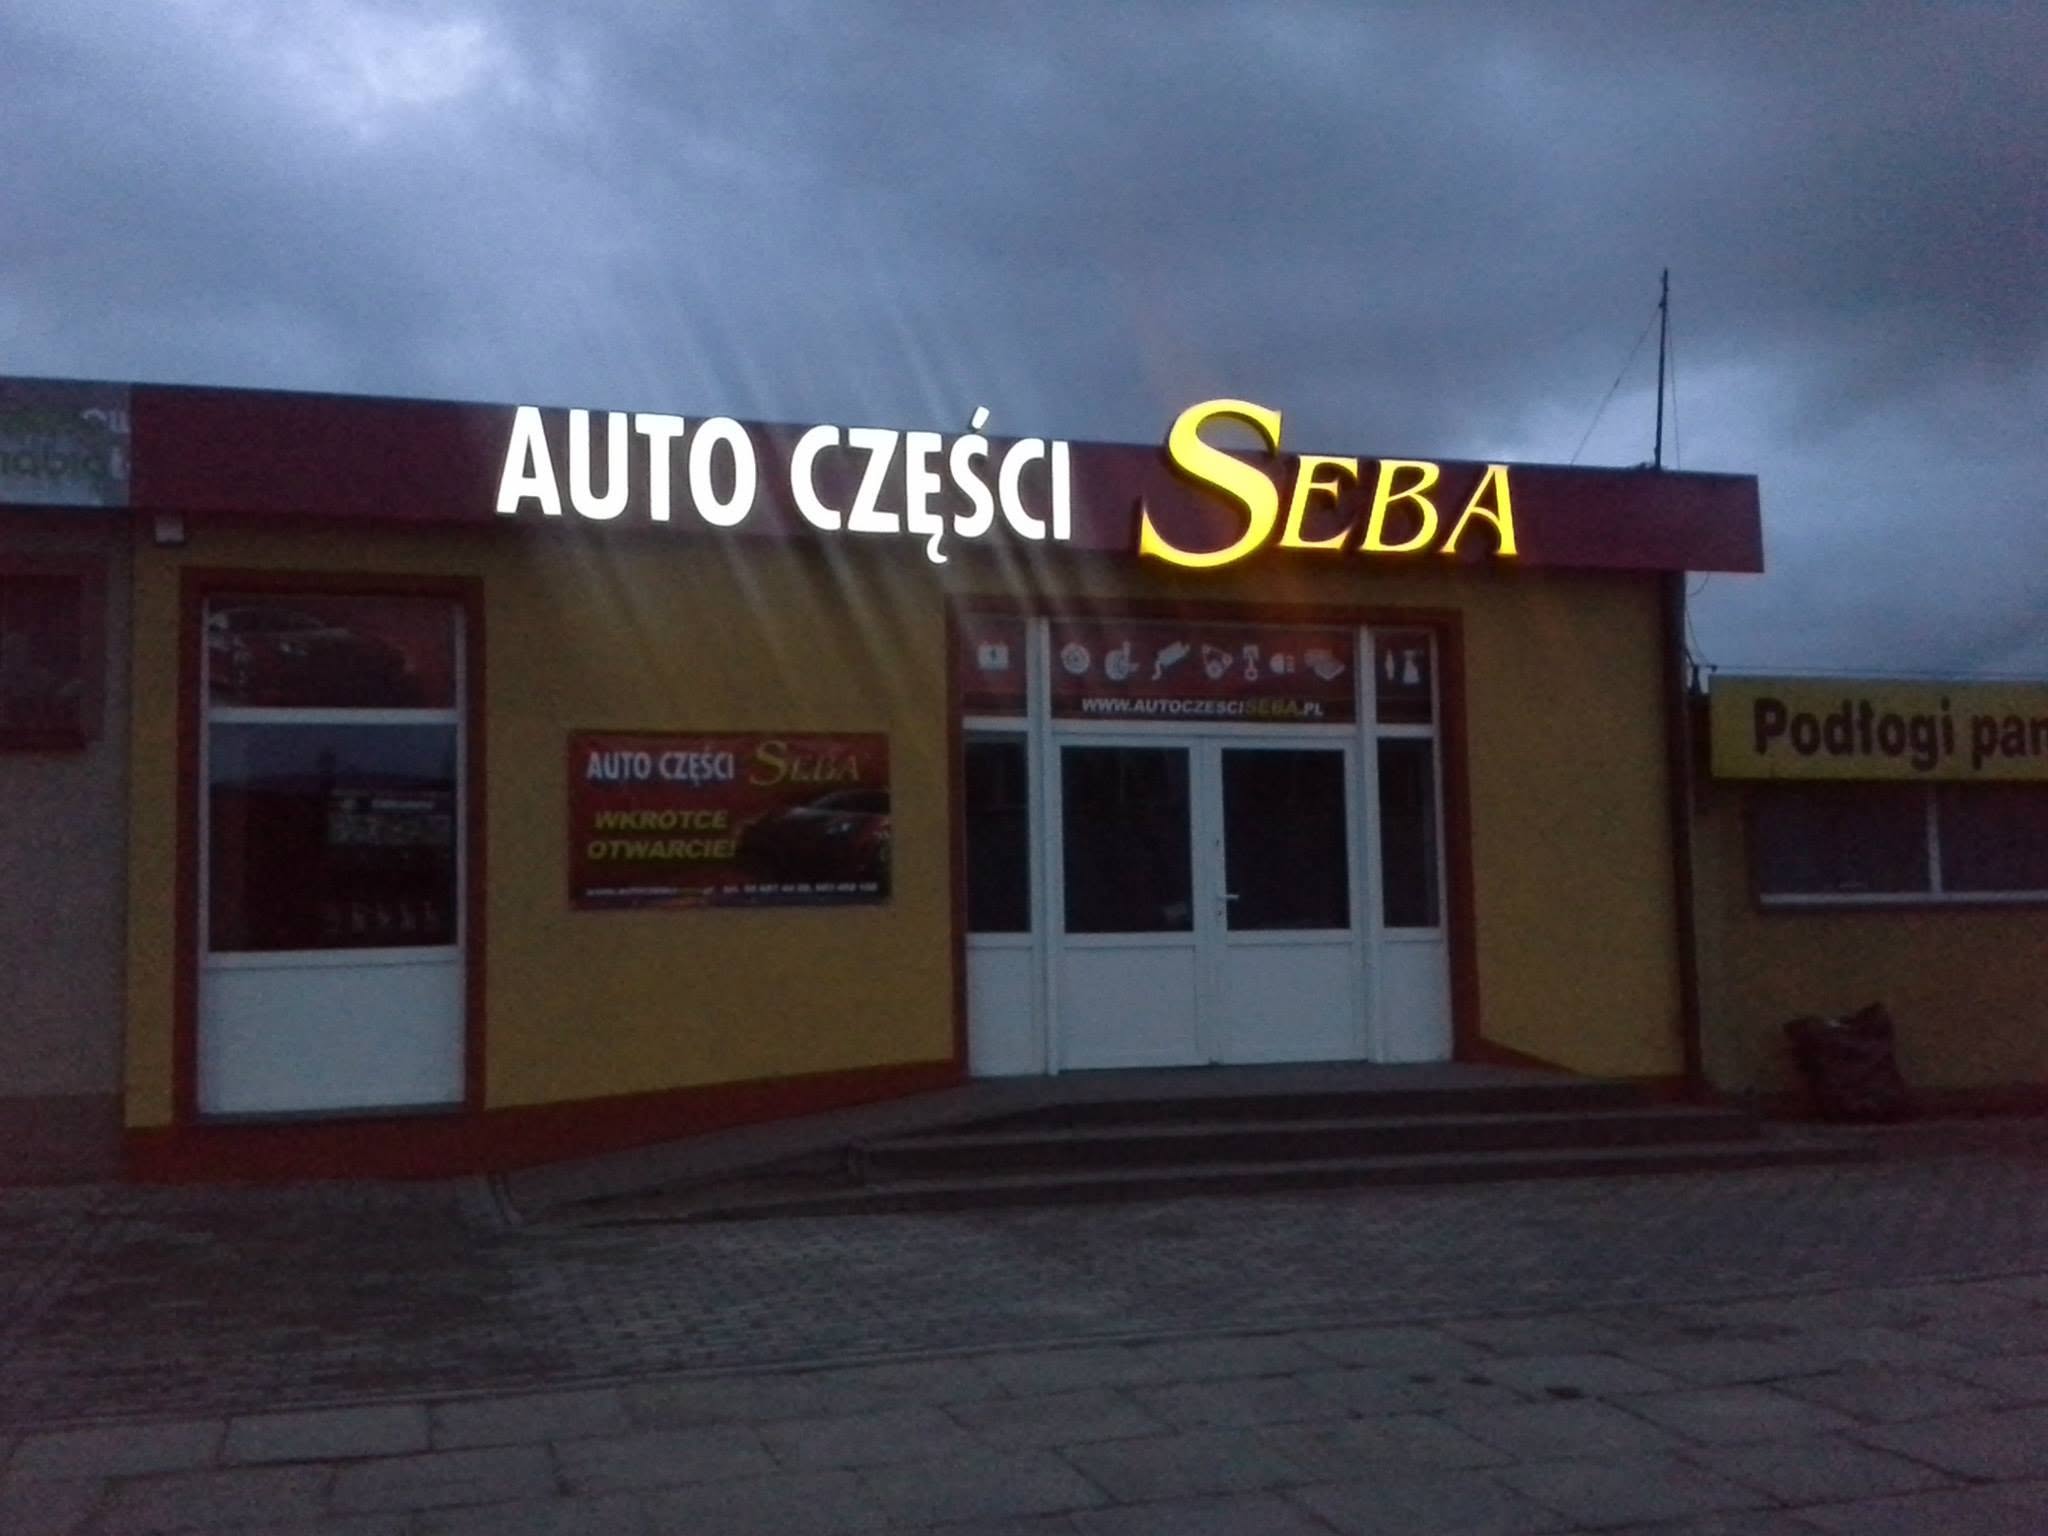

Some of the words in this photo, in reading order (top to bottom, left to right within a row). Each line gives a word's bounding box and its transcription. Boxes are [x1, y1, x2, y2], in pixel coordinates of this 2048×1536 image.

[496, 405, 757, 527] AUTO
[790, 405, 1072, 564] CZĘŚCI
[1138, 398, 1519, 568] SEBA
[1754, 696, 1954, 772] Podłogi
[586, 751, 652, 781] AUTO
[658, 744, 736, 787] CZĘŚCI
[586, 839, 738, 860] OTWARCIE!
